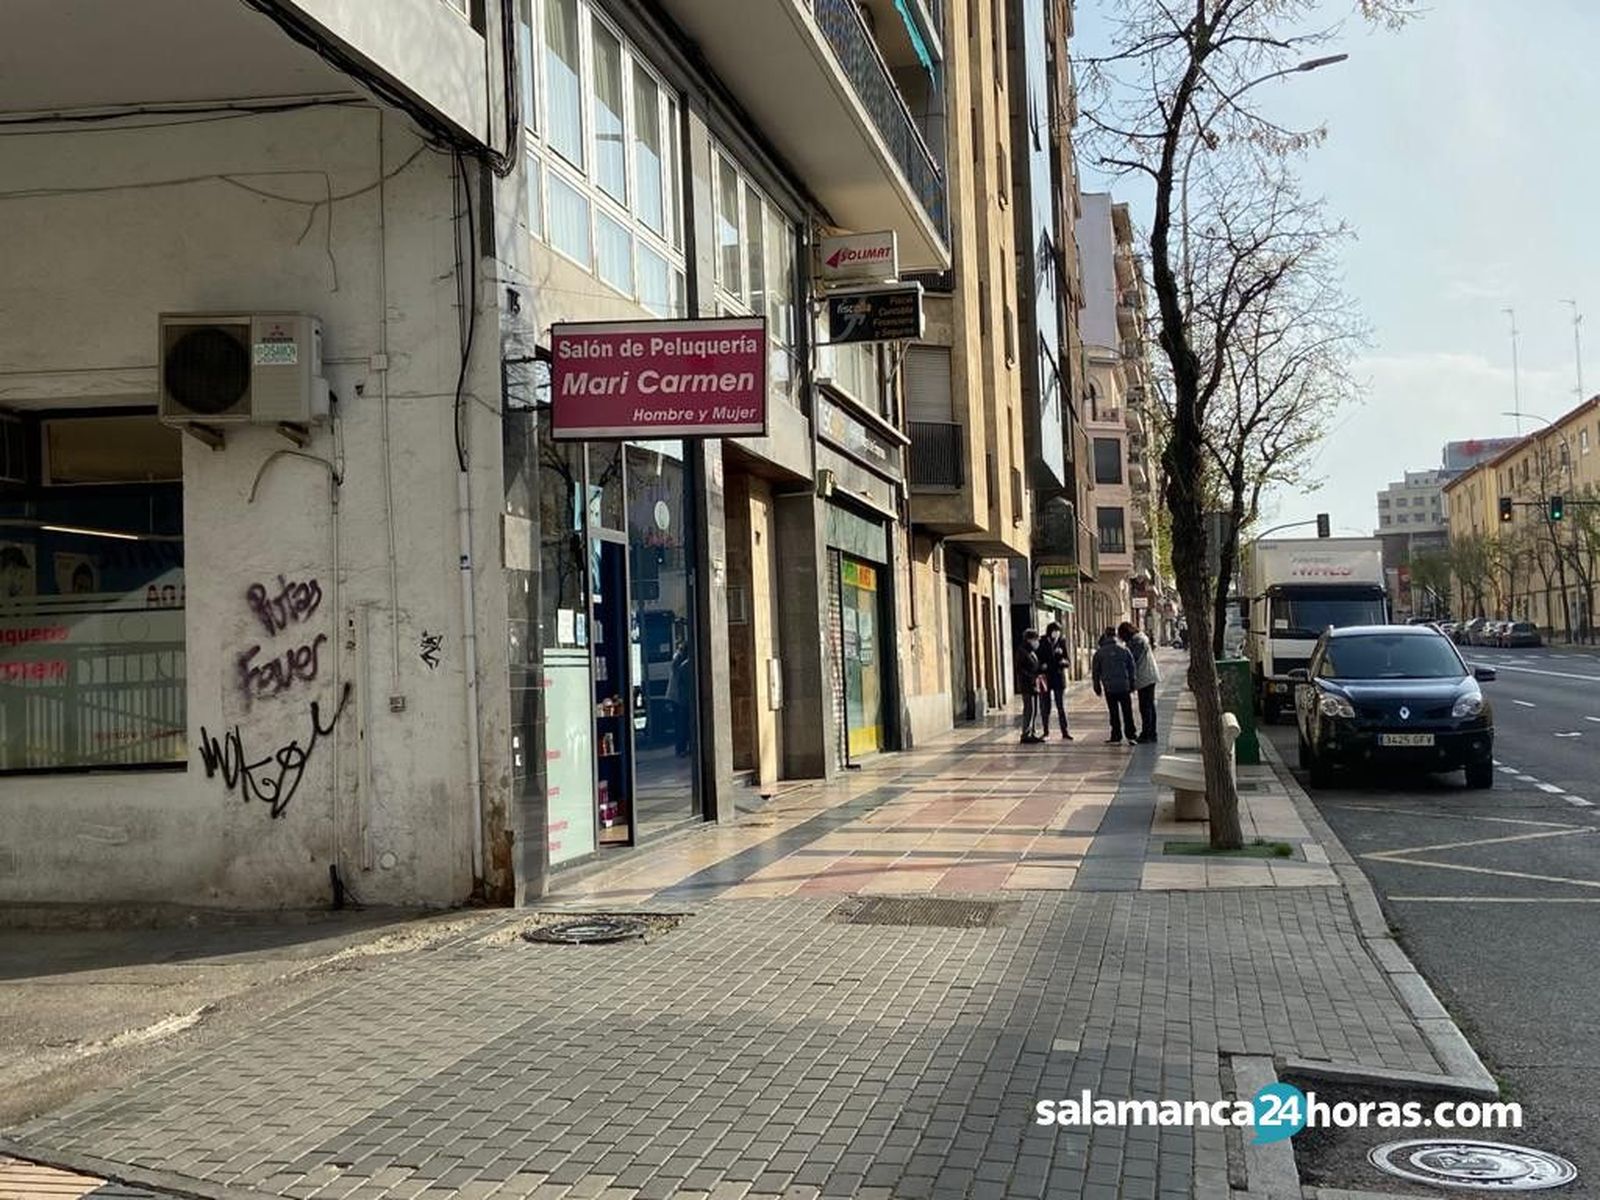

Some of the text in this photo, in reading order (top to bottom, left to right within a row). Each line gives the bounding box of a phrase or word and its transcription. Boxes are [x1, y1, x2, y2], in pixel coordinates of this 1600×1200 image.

[840, 247, 891, 262] SOLIMAT
[559, 335, 757, 359] Salón de Peluquería
[562, 370, 754, 395] Mari Carmen
[633, 407, 757, 422] Hombre y Mujer
